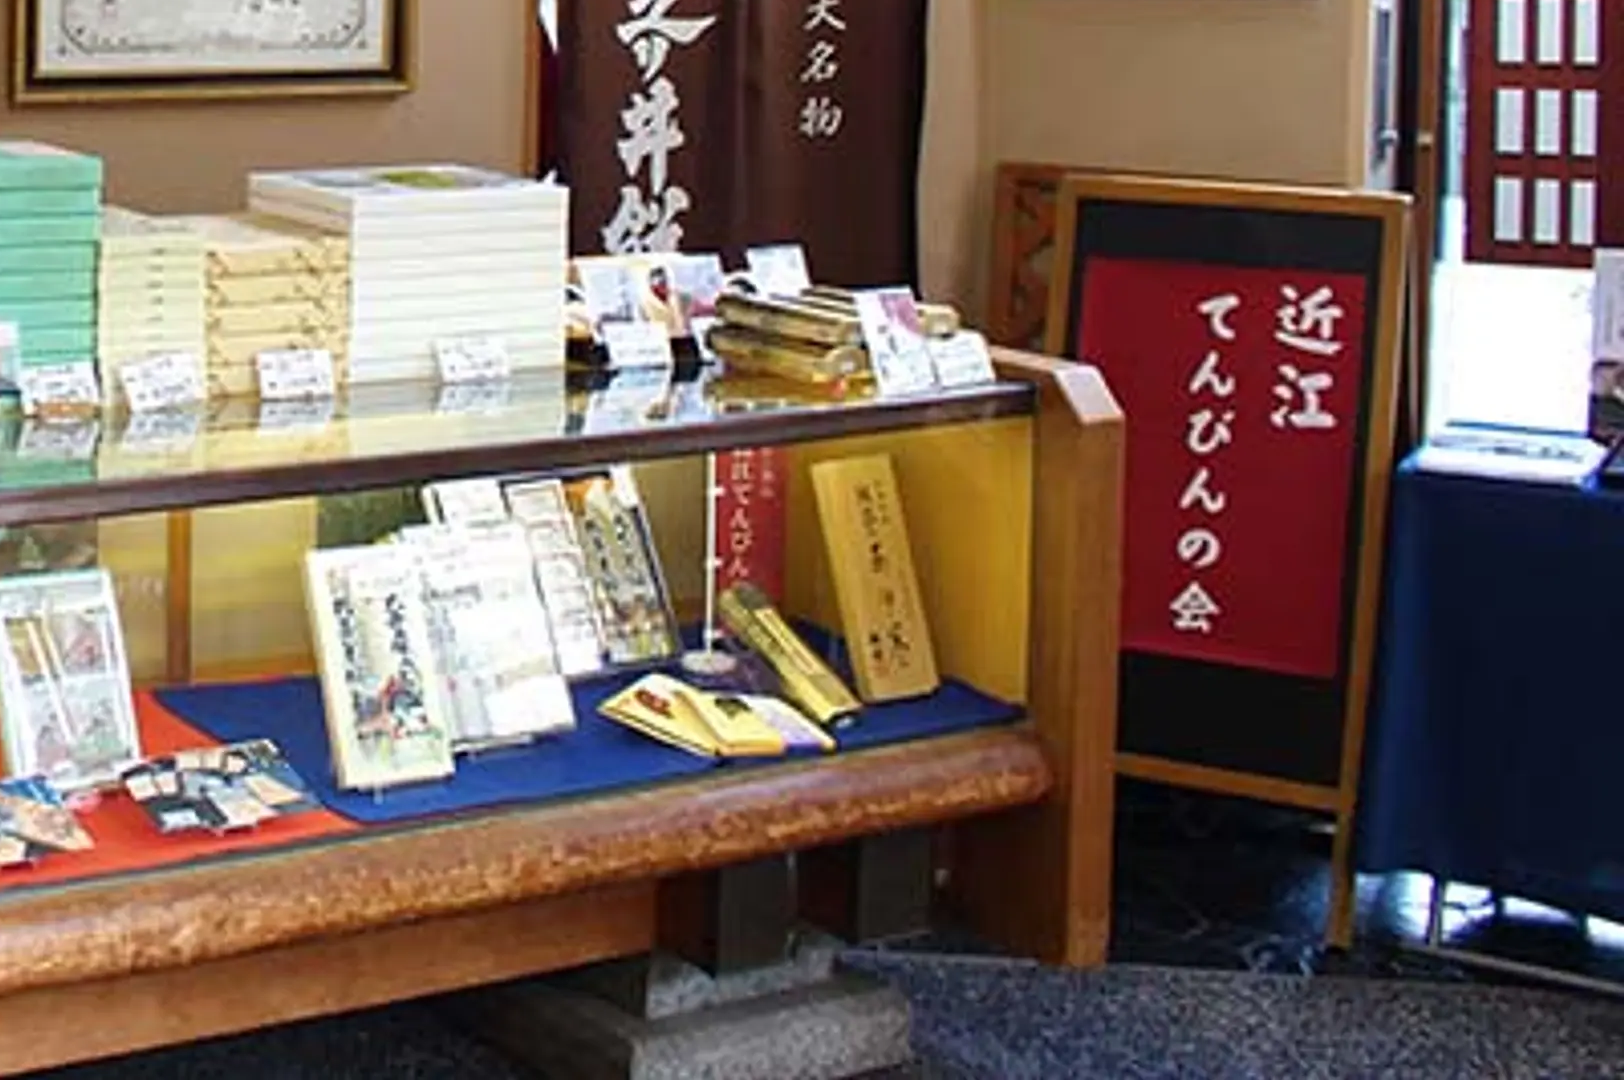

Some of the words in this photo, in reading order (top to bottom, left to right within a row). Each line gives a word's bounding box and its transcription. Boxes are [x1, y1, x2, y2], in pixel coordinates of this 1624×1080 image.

[1169, 294, 1241, 633] てんびんの会
[1270, 284, 1344, 429] 近江
